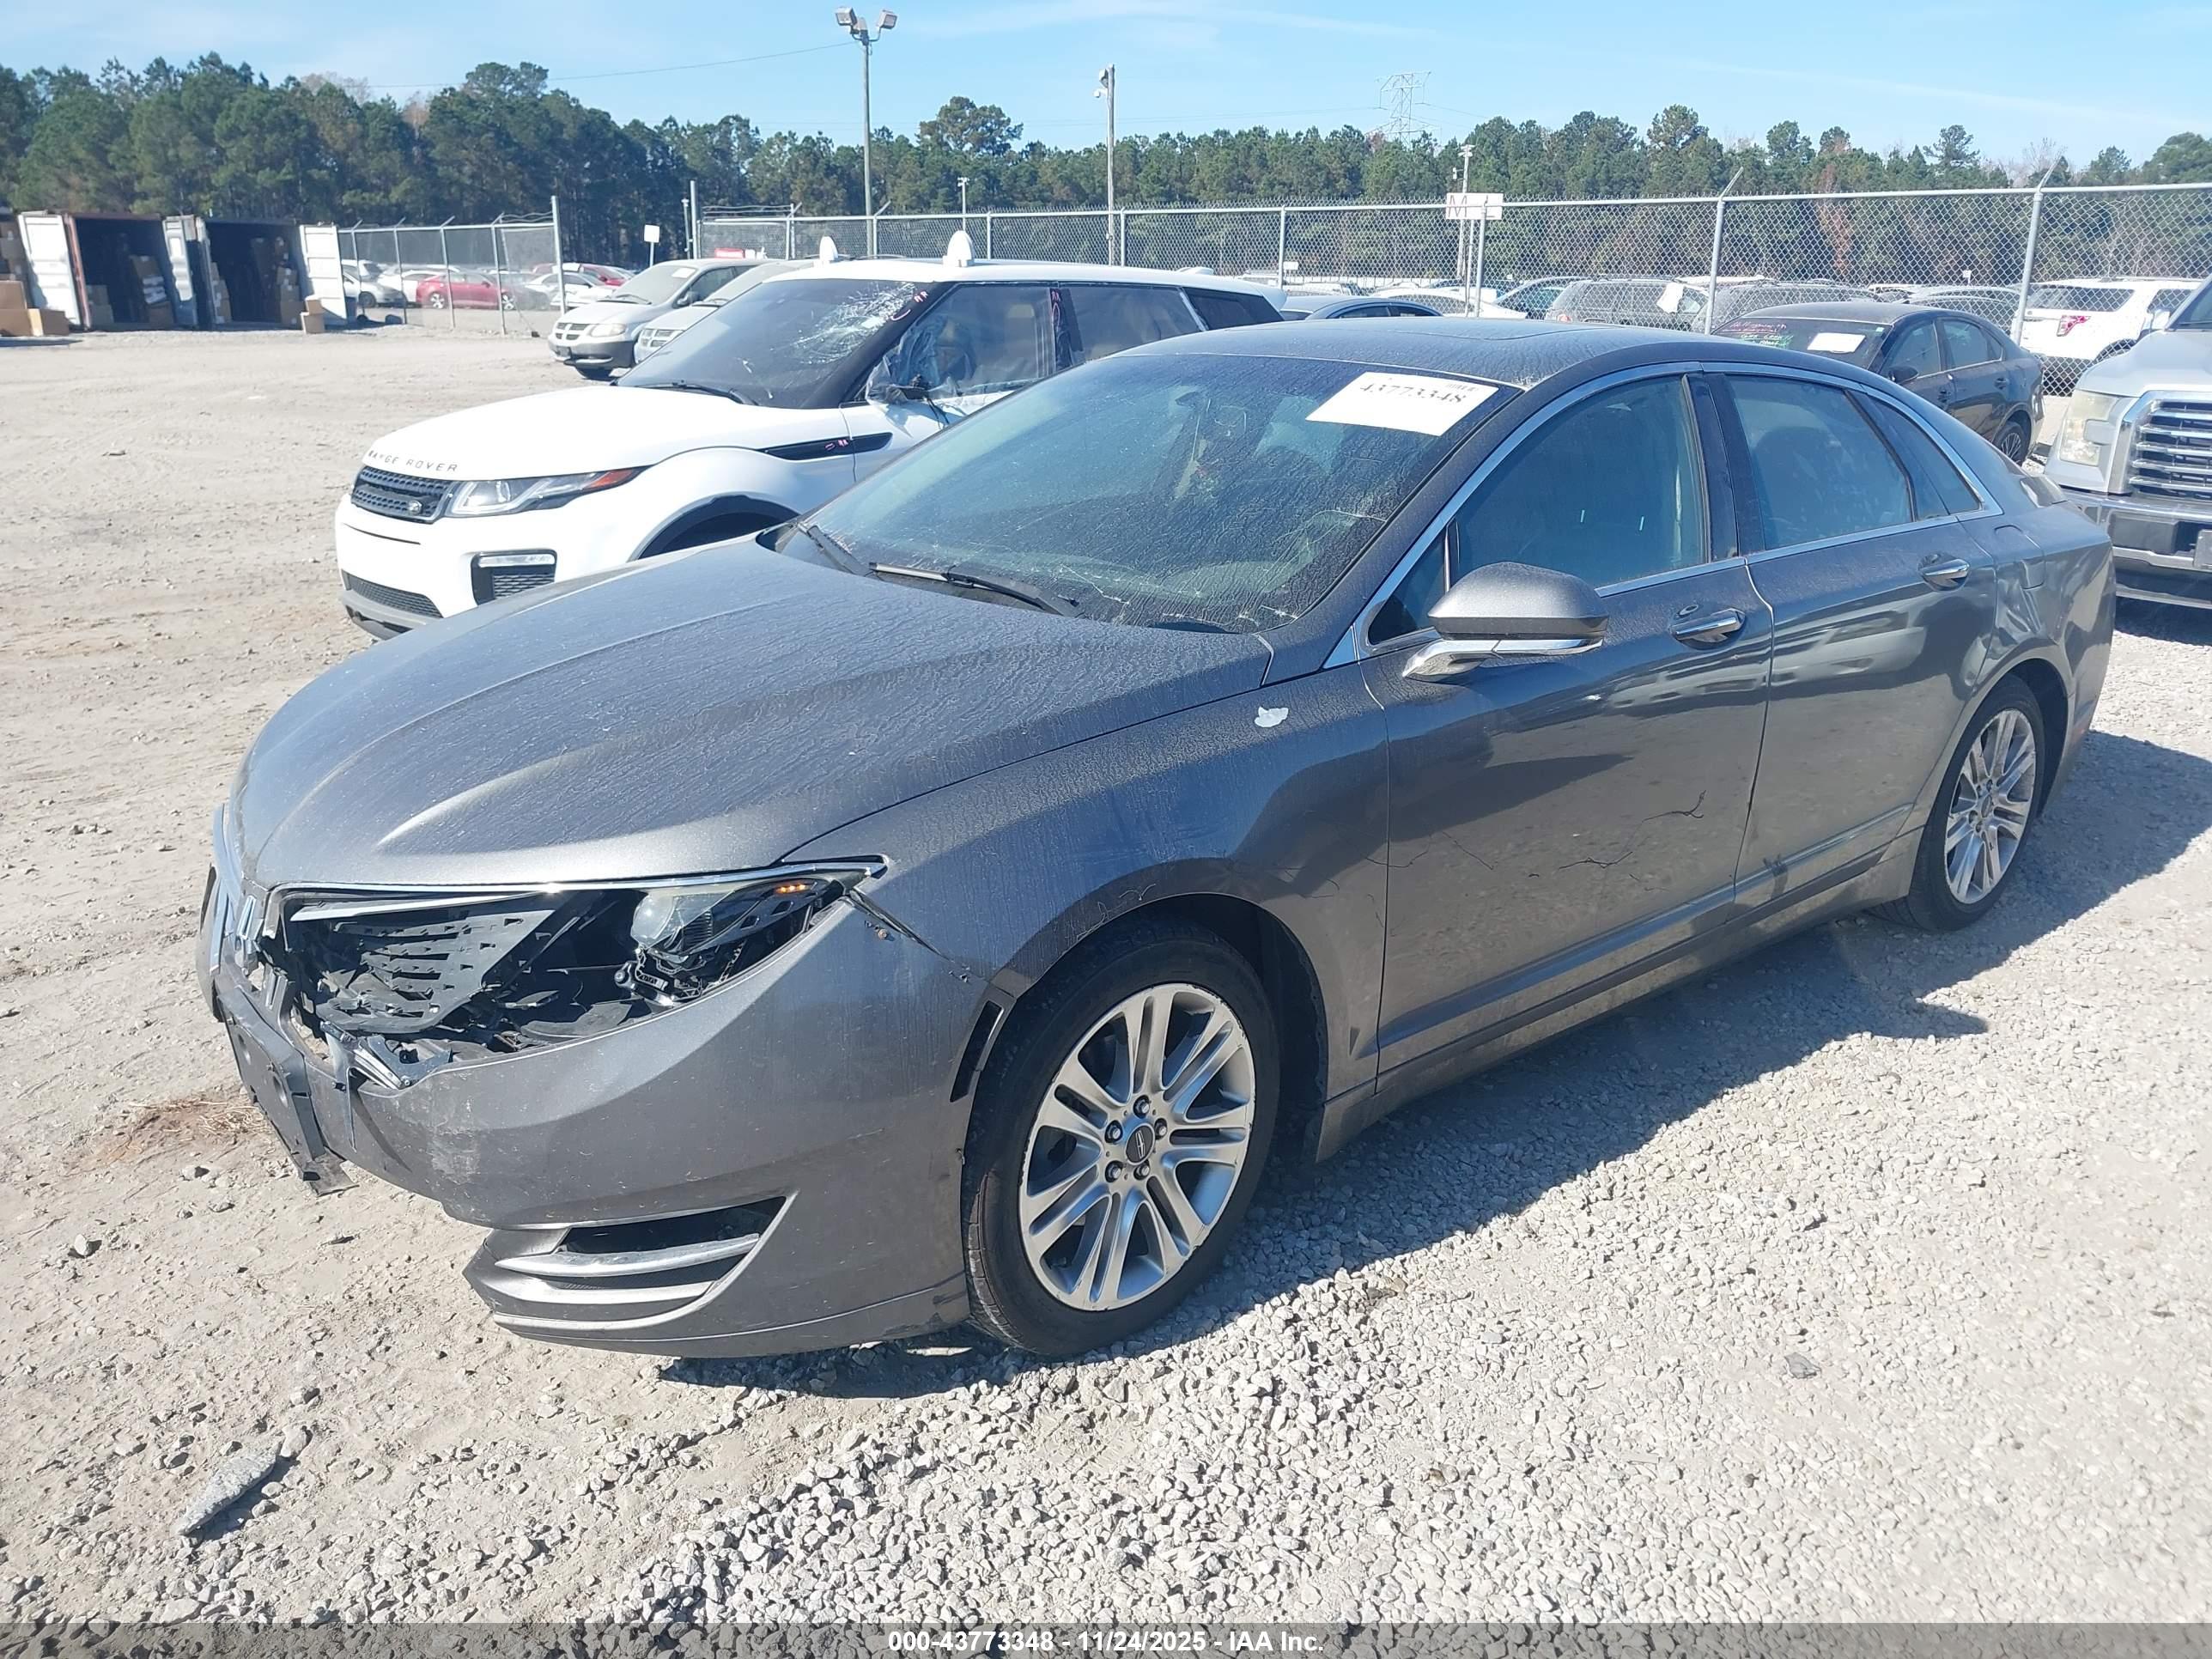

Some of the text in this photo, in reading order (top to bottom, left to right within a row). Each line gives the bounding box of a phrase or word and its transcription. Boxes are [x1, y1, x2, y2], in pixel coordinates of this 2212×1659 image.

[1448, 194, 1468, 218] M
[1360, 382, 1467, 403] 43773348
[405, 459, 458, 472] ROVER
